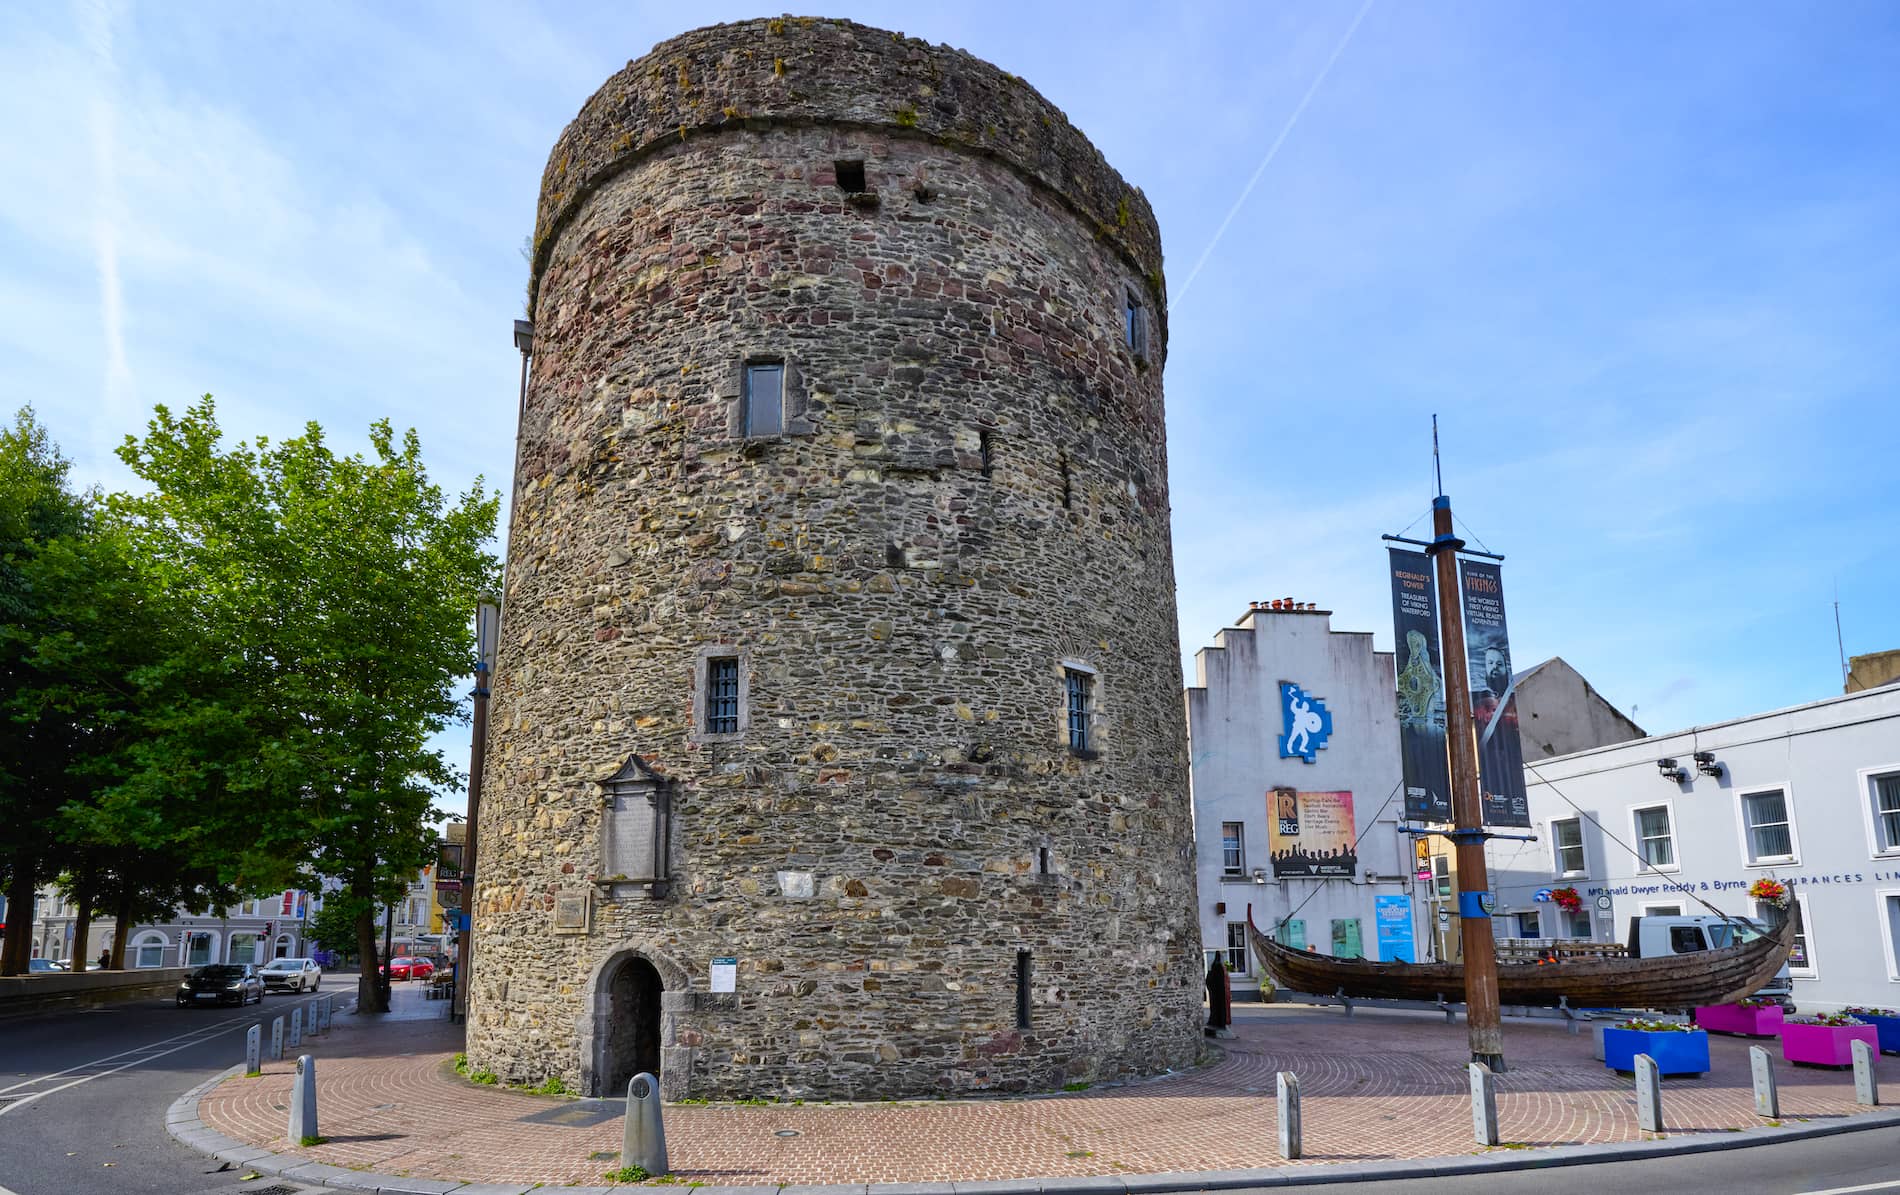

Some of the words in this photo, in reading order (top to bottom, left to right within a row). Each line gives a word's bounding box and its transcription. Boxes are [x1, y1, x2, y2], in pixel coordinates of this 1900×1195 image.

[1395, 570, 1430, 583] REGINALD'S
[1402, 579, 1425, 590] TOWER
[1465, 575, 1498, 593] VIKINGS
[1400, 592, 1428, 602] TREASURES
[1467, 595, 1477, 603] THE
[1478, 597, 1500, 606] WORLD'S
[1401, 599, 1409, 607] OF
[1410, 600, 1429, 610] VIKING
[1469, 603, 1481, 611] FIRST
[1482, 604, 1499, 613] VIKING
[1400, 606, 1430, 617] WATERFORD
[1466, 610, 1485, 619] VIRTUAL
[1485, 612, 1503, 621] REALITY
[1471, 617, 1499, 627] ADVENTURE
[1280, 823, 1299, 834] REG
[440, 869, 457, 878] REG
[1631, 884, 1660, 896] Dwyer
[1663, 882, 1696, 893] Reddy
[1700, 881, 1709, 891] &
[1713, 880, 1747, 890] Byrne
[1774, 873, 1863, 886] SURANCES
